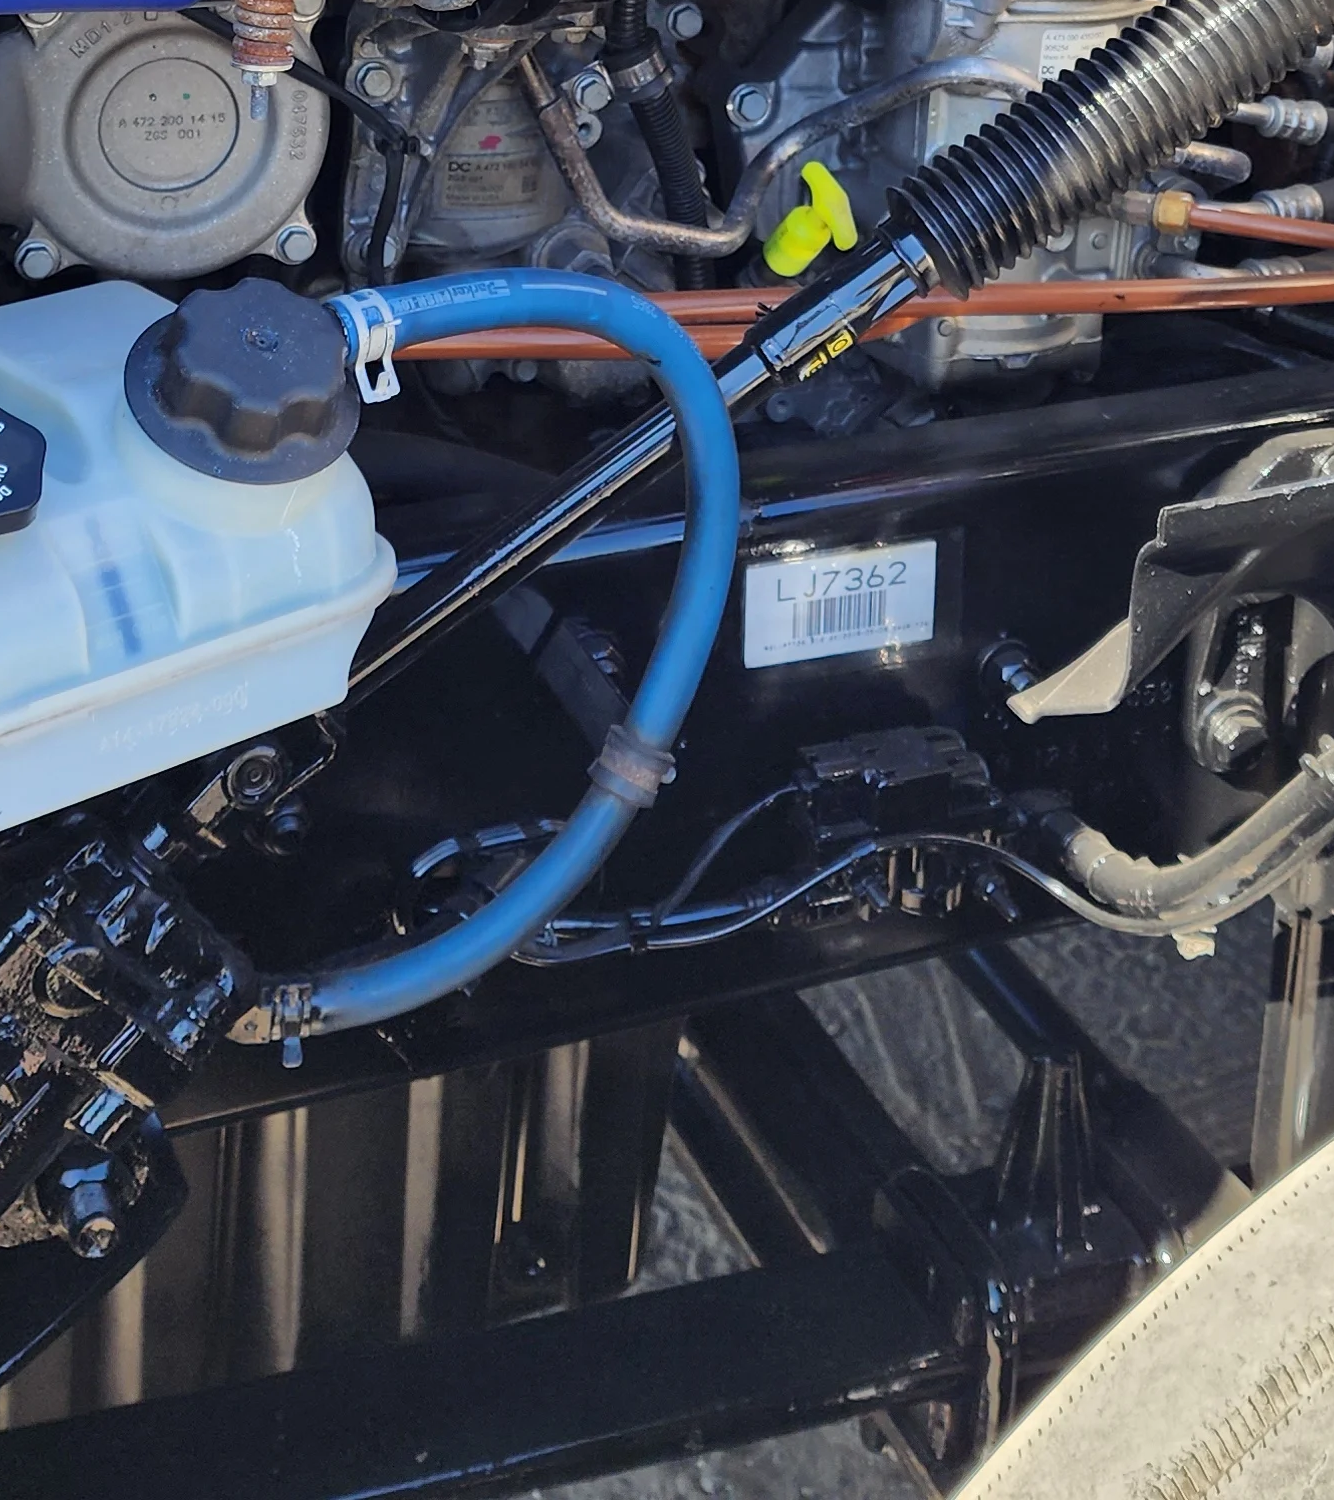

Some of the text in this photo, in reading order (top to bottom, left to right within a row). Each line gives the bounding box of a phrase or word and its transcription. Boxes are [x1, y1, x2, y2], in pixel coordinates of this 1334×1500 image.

[1041, 66, 1055, 74] DC
[118, 120, 127, 128] A
[133, 117, 155, 127] 472
[191, 115, 205, 124] 14
[178, 129, 201, 140] 001
[449, 162, 471, 172] DC
